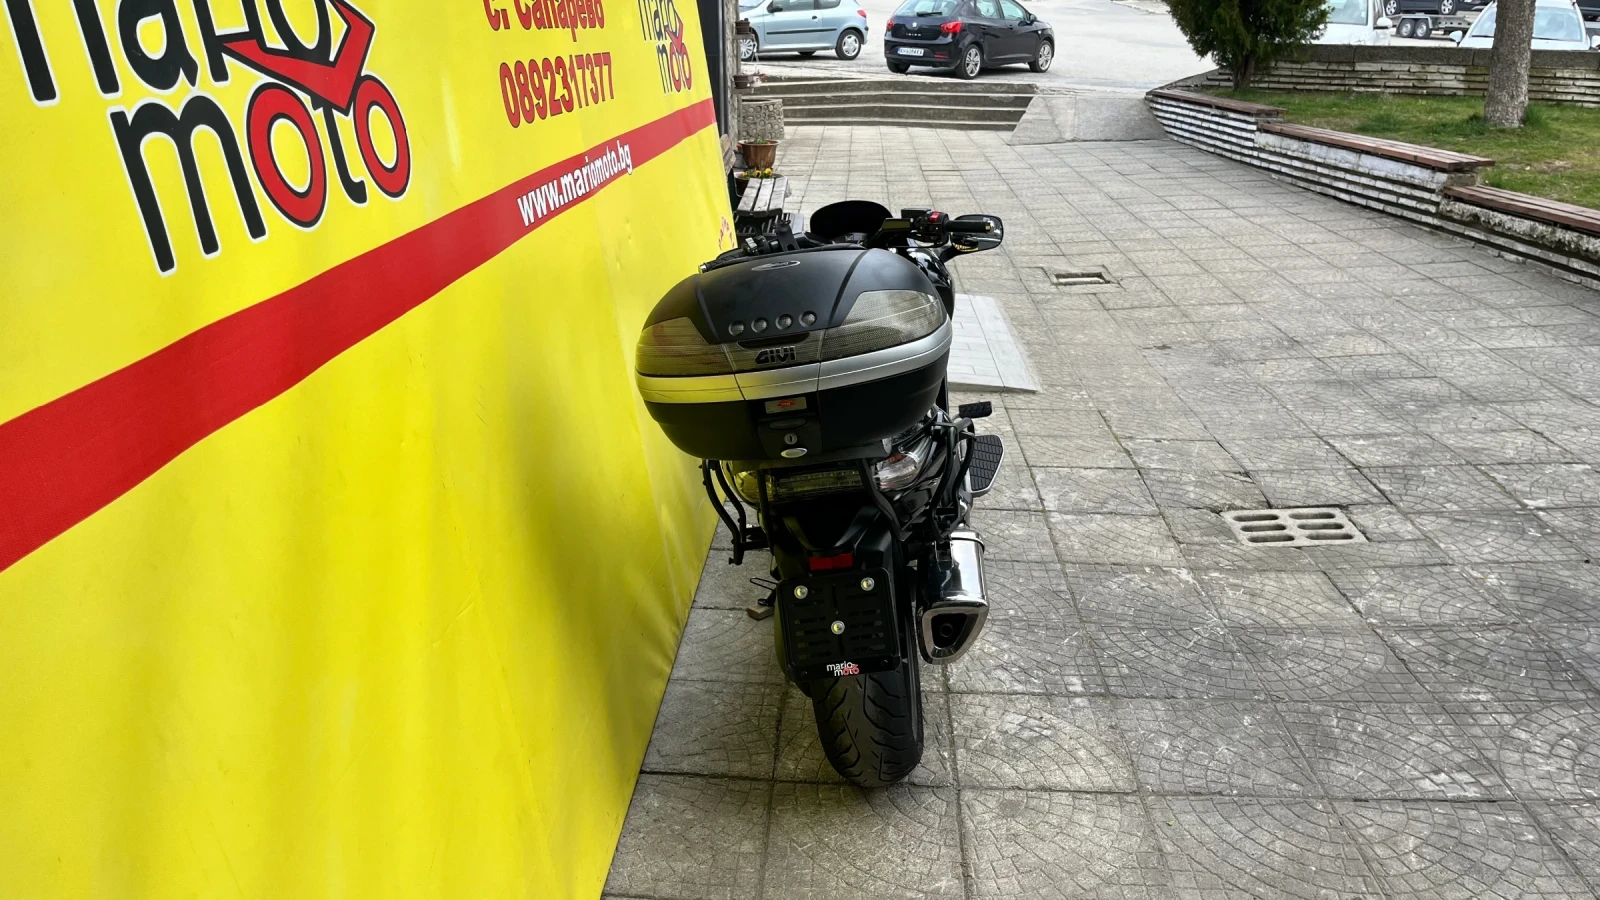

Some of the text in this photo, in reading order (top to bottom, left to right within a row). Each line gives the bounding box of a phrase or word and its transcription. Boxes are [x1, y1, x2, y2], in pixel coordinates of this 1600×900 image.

[499, 51, 615, 128] 0892317377
[656, 42, 692, 94] moto
[109, 76, 411, 274] moto
[517, 140, 633, 227] www.mariomoto.bg
[755, 345, 797, 364] GIVI
[826, 660, 853, 671] mario
[834, 667, 860, 676] moto
